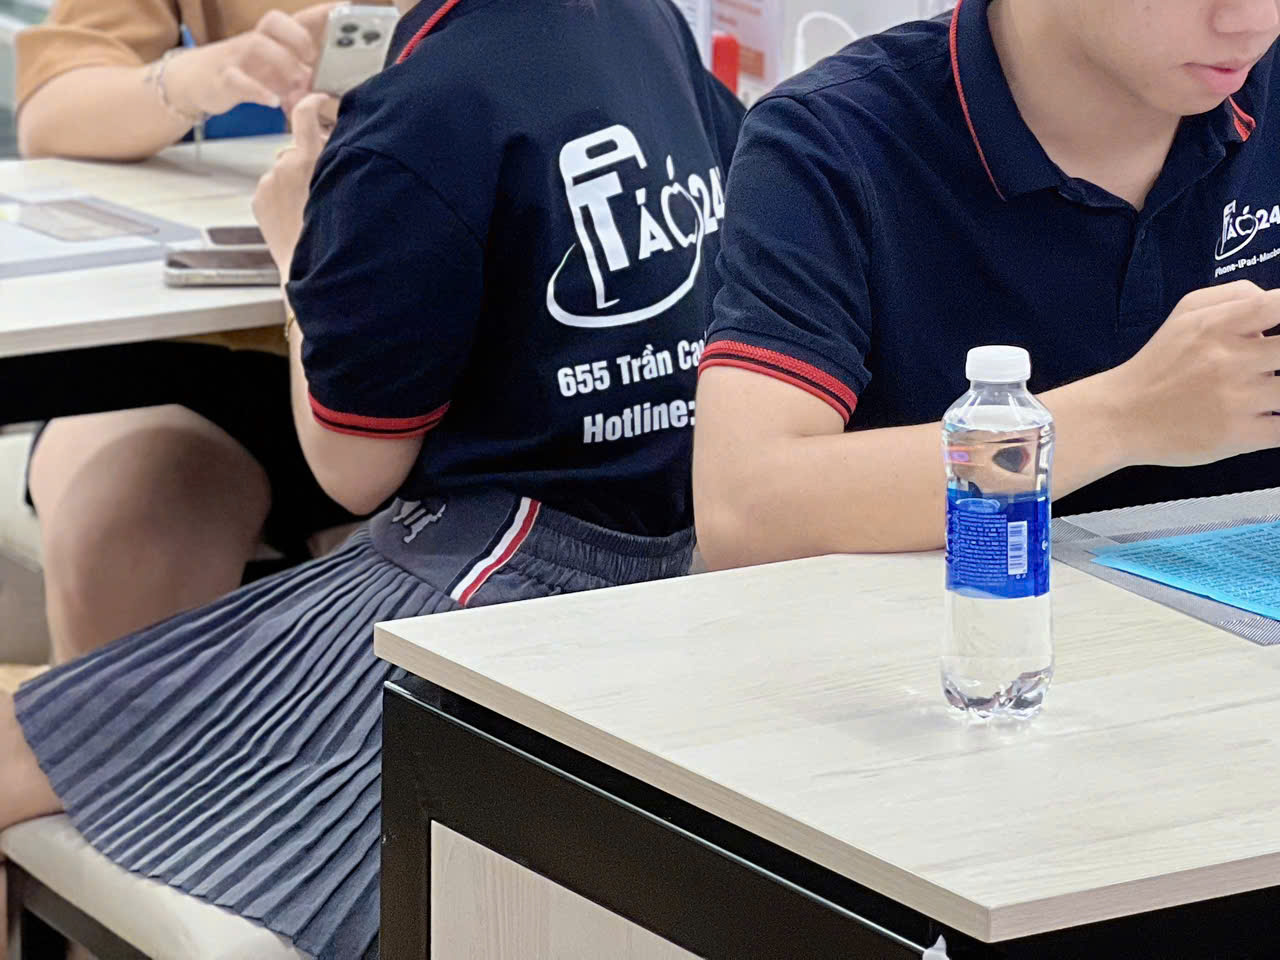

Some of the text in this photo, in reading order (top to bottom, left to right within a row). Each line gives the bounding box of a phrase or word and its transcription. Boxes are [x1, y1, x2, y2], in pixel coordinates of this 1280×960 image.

[557, 360, 611, 398] 655
[617, 344, 674, 387] Trần
[583, 398, 696, 444] Hotline:
